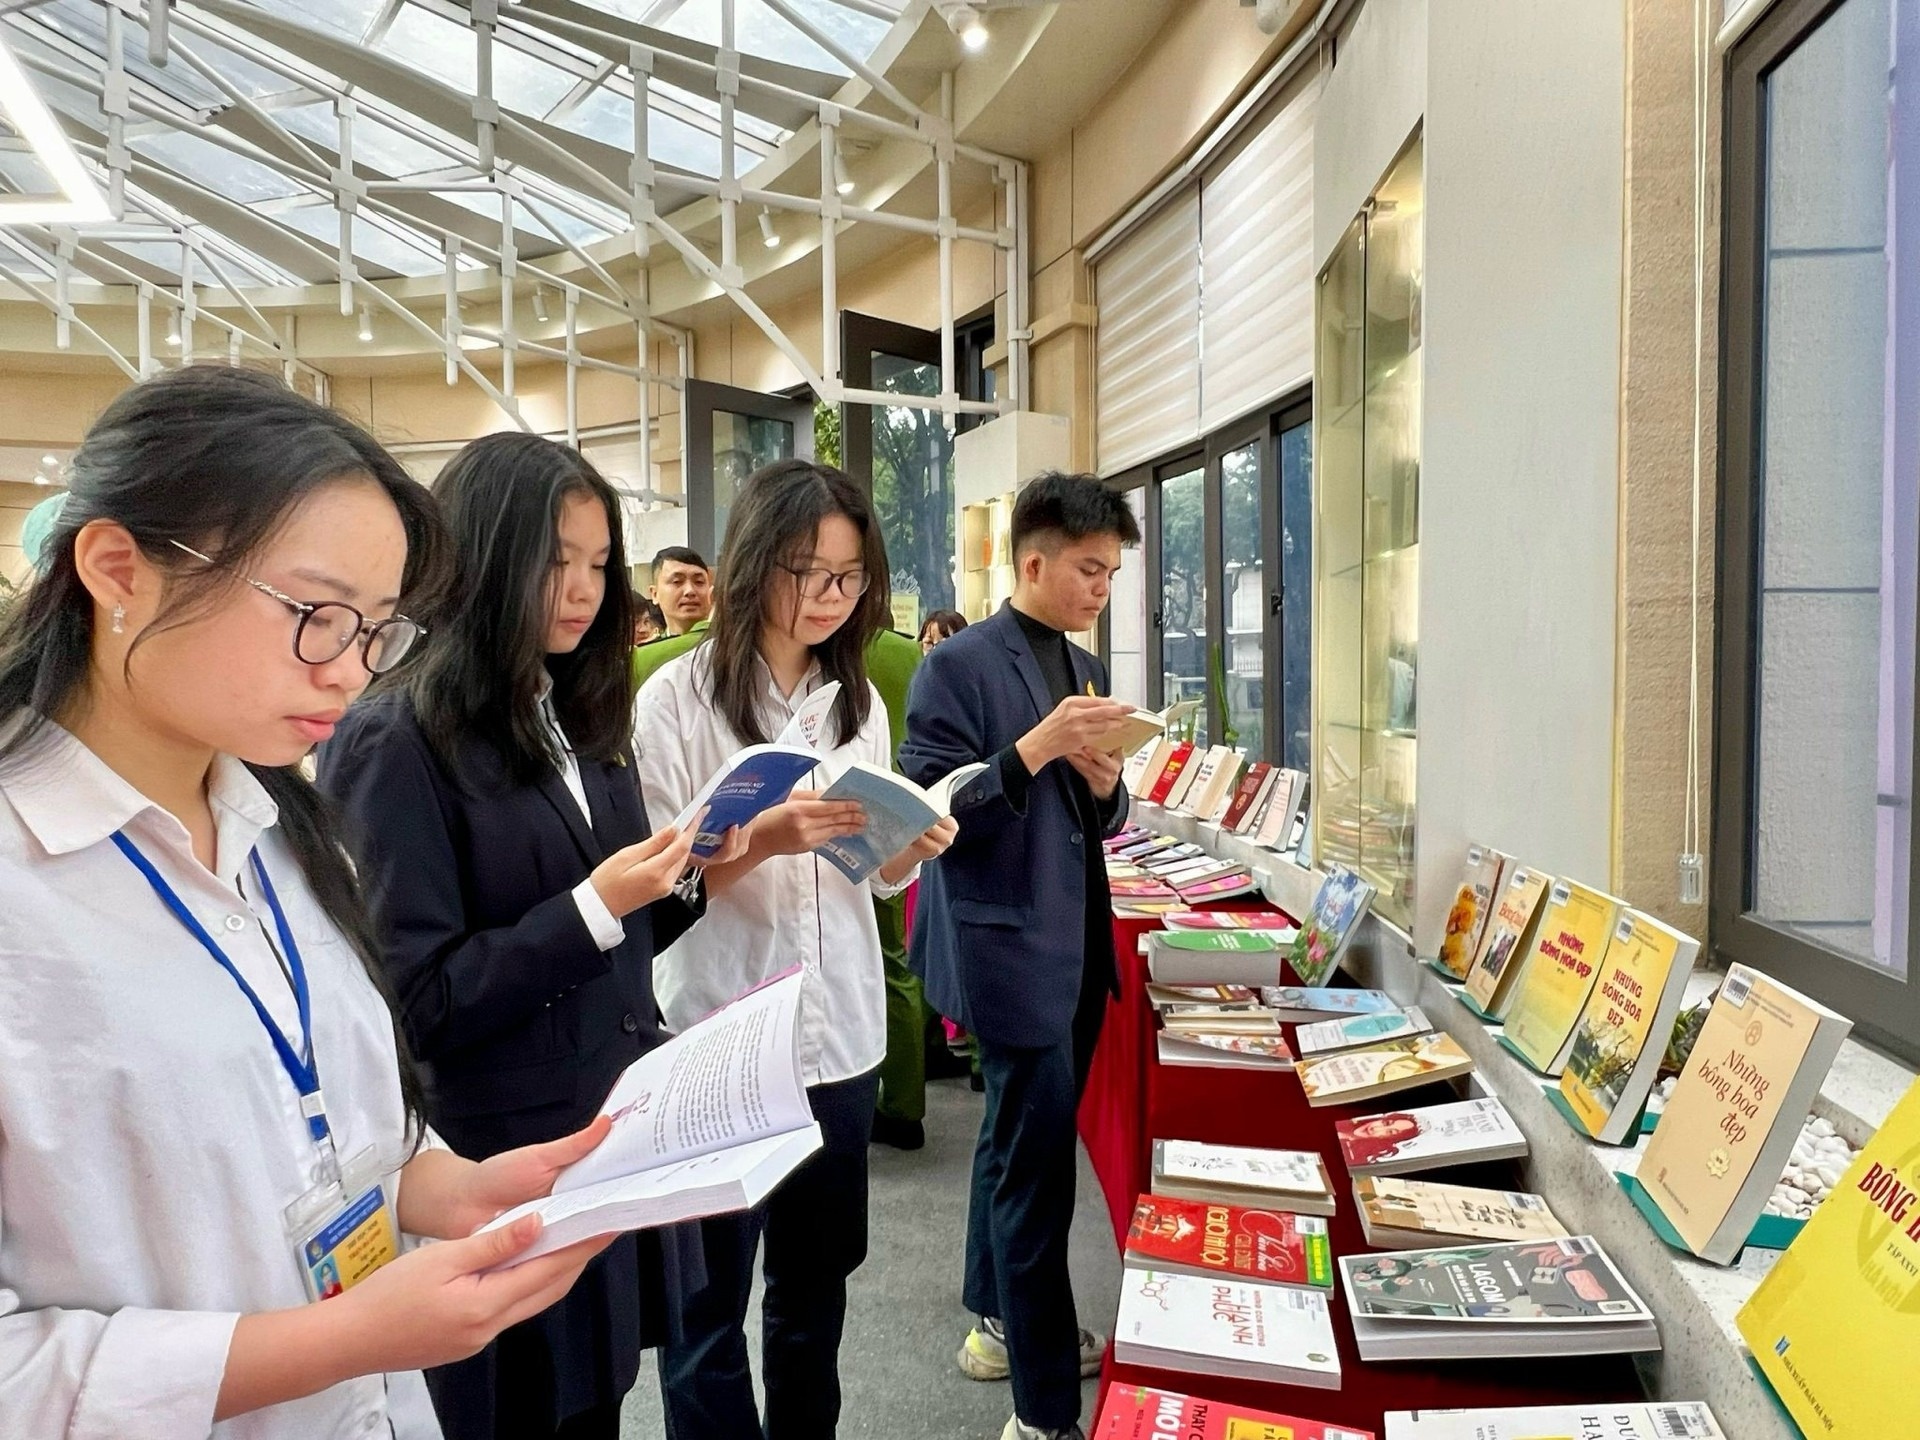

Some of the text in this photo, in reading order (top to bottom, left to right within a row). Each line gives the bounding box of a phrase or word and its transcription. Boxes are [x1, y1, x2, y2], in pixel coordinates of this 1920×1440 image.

[1623, 998, 1642, 1022] HOA
[1698, 1058, 1759, 1119] bông hoa
[1720, 1112, 1747, 1145] đẹp
[1858, 1162, 1918, 1224] BÔNG
[1467, 1262, 1506, 1304] LAGOM
[1156, 1397, 1184, 1432] MỞ
[1192, 1405, 1208, 1431] THAY
